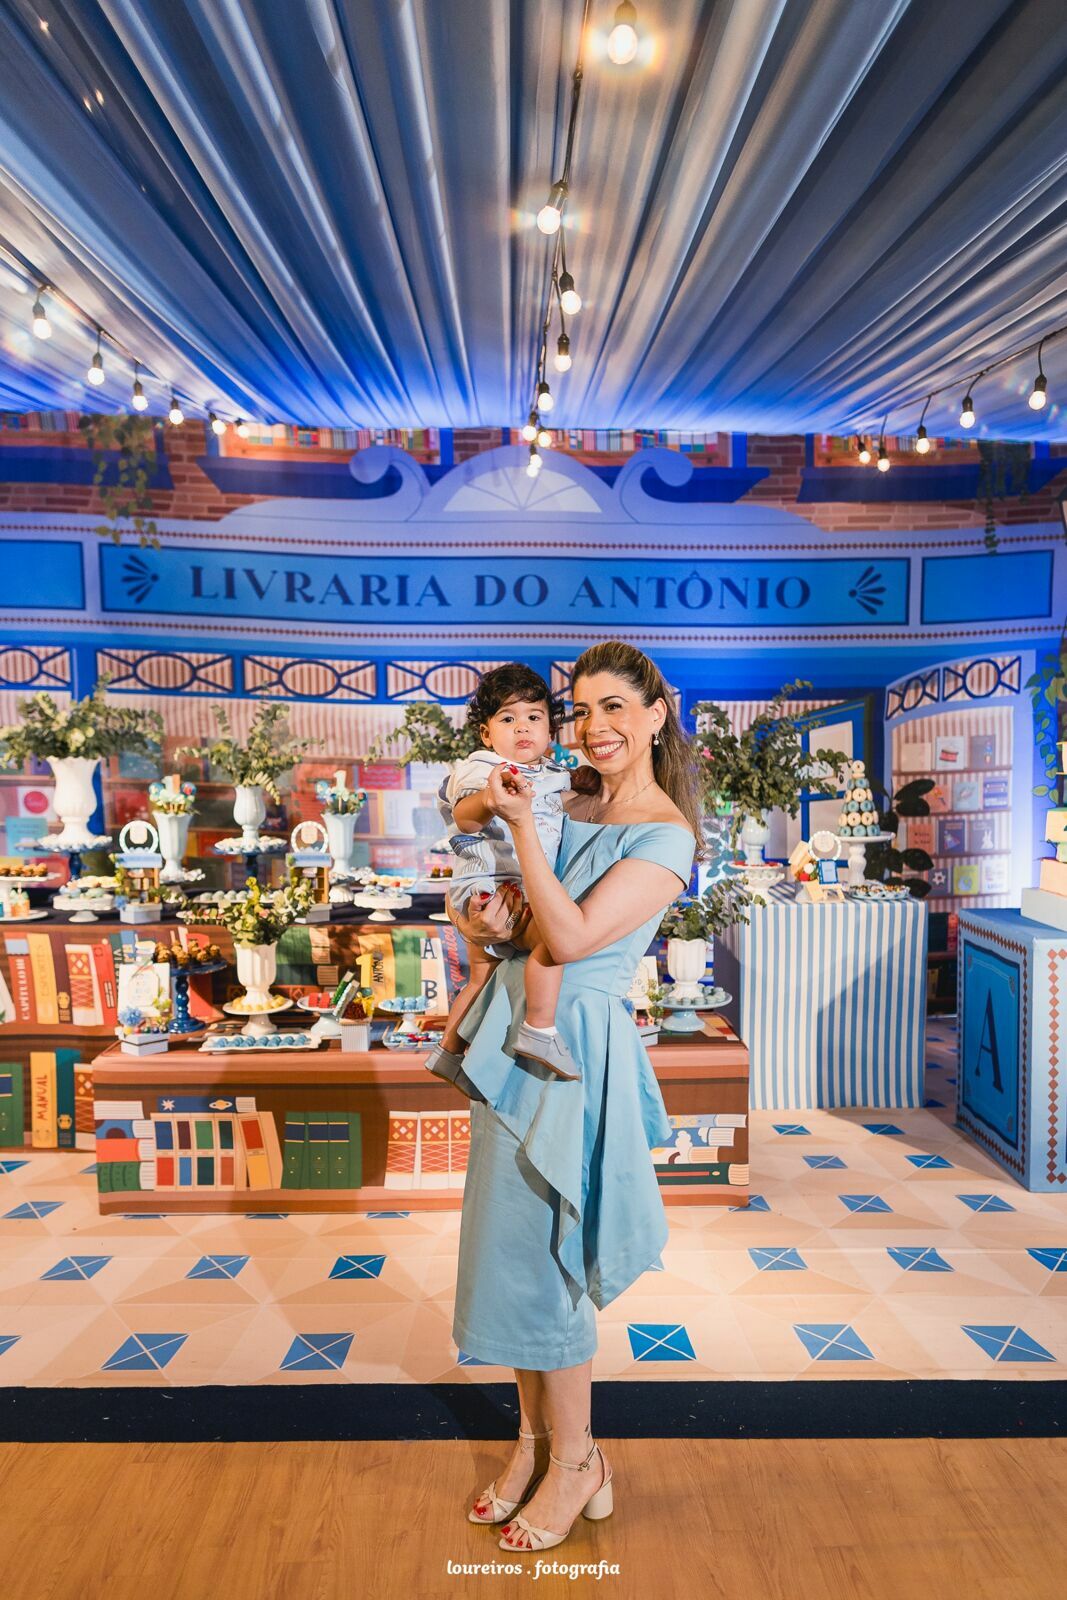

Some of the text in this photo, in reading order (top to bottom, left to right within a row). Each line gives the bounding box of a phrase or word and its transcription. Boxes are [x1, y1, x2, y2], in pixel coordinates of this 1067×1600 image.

[190, 565, 811, 609] LIVRARIA DO ANTÔNIO
[420, 938, 437, 960] A
[17, 970, 31, 1021] CAPÍTULO
[421, 979, 438, 1000] B
[974, 987, 1005, 1095] A
[36, 1074, 48, 1121] MANUAL
